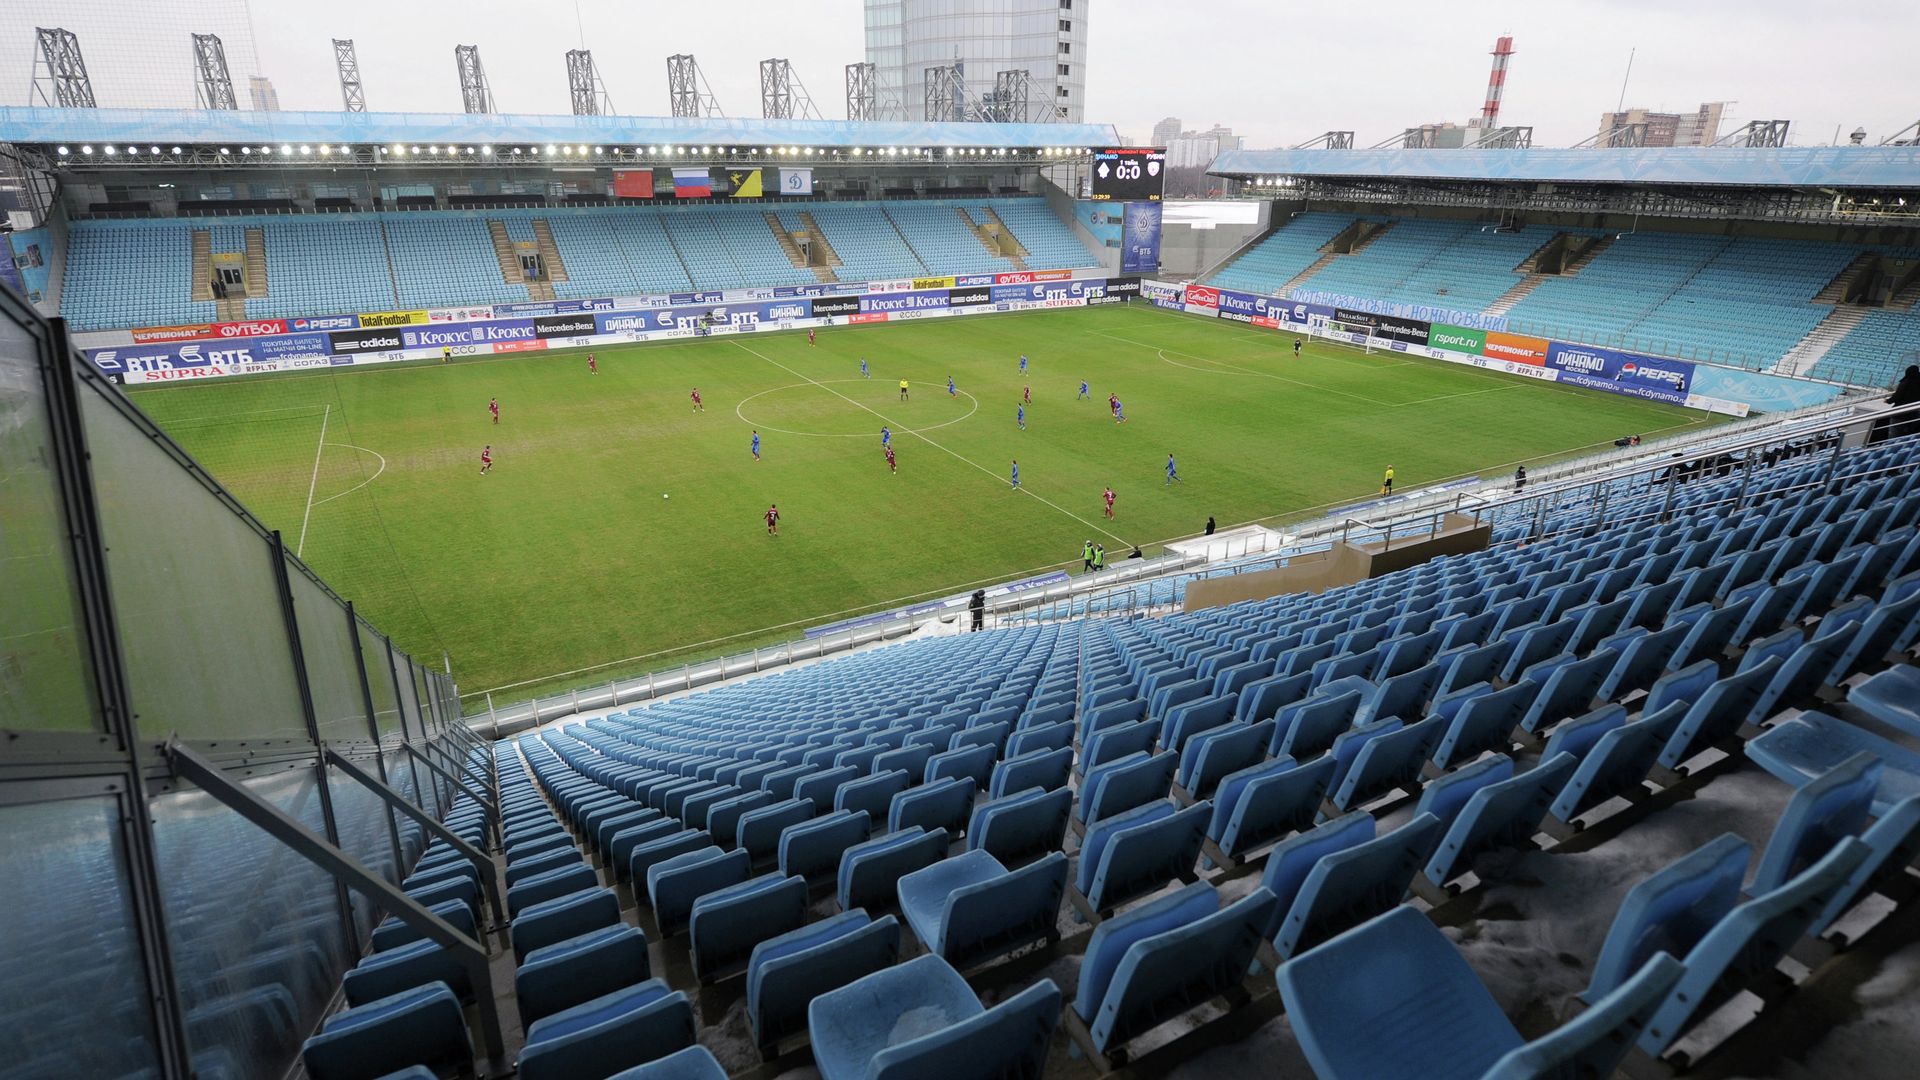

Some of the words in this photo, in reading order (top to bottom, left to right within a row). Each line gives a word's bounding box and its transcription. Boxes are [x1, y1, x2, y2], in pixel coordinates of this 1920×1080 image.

[1116, 166, 1140, 180] 0:0
[968, 276, 992, 284] PEPSI
[1000, 274, 1030, 283] ФУТБОЛ
[1046, 289, 1068, 300] ВТБ
[1084, 286, 1104, 298] ВТБ
[916, 296, 950, 306] КРОКУС
[966, 294, 988, 302] adidas
[1226, 296, 1254, 310] КРОКУС
[814, 302, 858, 313] Mercedes-Benz
[872, 300, 906, 310] КРОКУС
[770, 306, 804, 318] ДИНАМО
[900, 311, 922, 319] ecco
[1232, 313, 1252, 322] adidas
[1268, 306, 1289, 321] ВТБ
[310, 318, 352, 328] PEPSI
[360, 314, 412, 327] TotalFootball
[606, 318, 646, 330] ДИНАМО
[731, 312, 760, 325] ВТБ
[221, 323, 280, 336] ФУТБОЛ
[488, 326, 534, 340] КРОКУС
[537, 323, 594, 334] Mercedes-Benz
[1380, 323, 1428, 338] Mercedes-Benz
[420, 330, 470, 344] КРОКУС
[1330, 332, 1350, 340] СОГАЗ
[1434, 334, 1478, 348] rsport.ru
[262, 339, 293, 348] ПОКУПАЙ
[360, 337, 400, 348] adidas
[208, 349, 254, 367] ВТБ
[1432, 350, 1444, 358] ВТБ
[126, 355, 173, 372] ВТБ
[1474, 358, 1487, 366] ВТБ
[1556, 352, 1604, 371] ДИНАМО
[146, 367, 224, 380] SUPRA
[246, 364, 278, 372] RFPL.TV
[1516, 367, 1544, 378] RFPL.TV
[1565, 365, 1590, 374] МОСКВА
[1563, 376, 1620, 390] www.fcdynamo.ru
[1624, 387, 1686, 404] www.fcdynamo.ru
